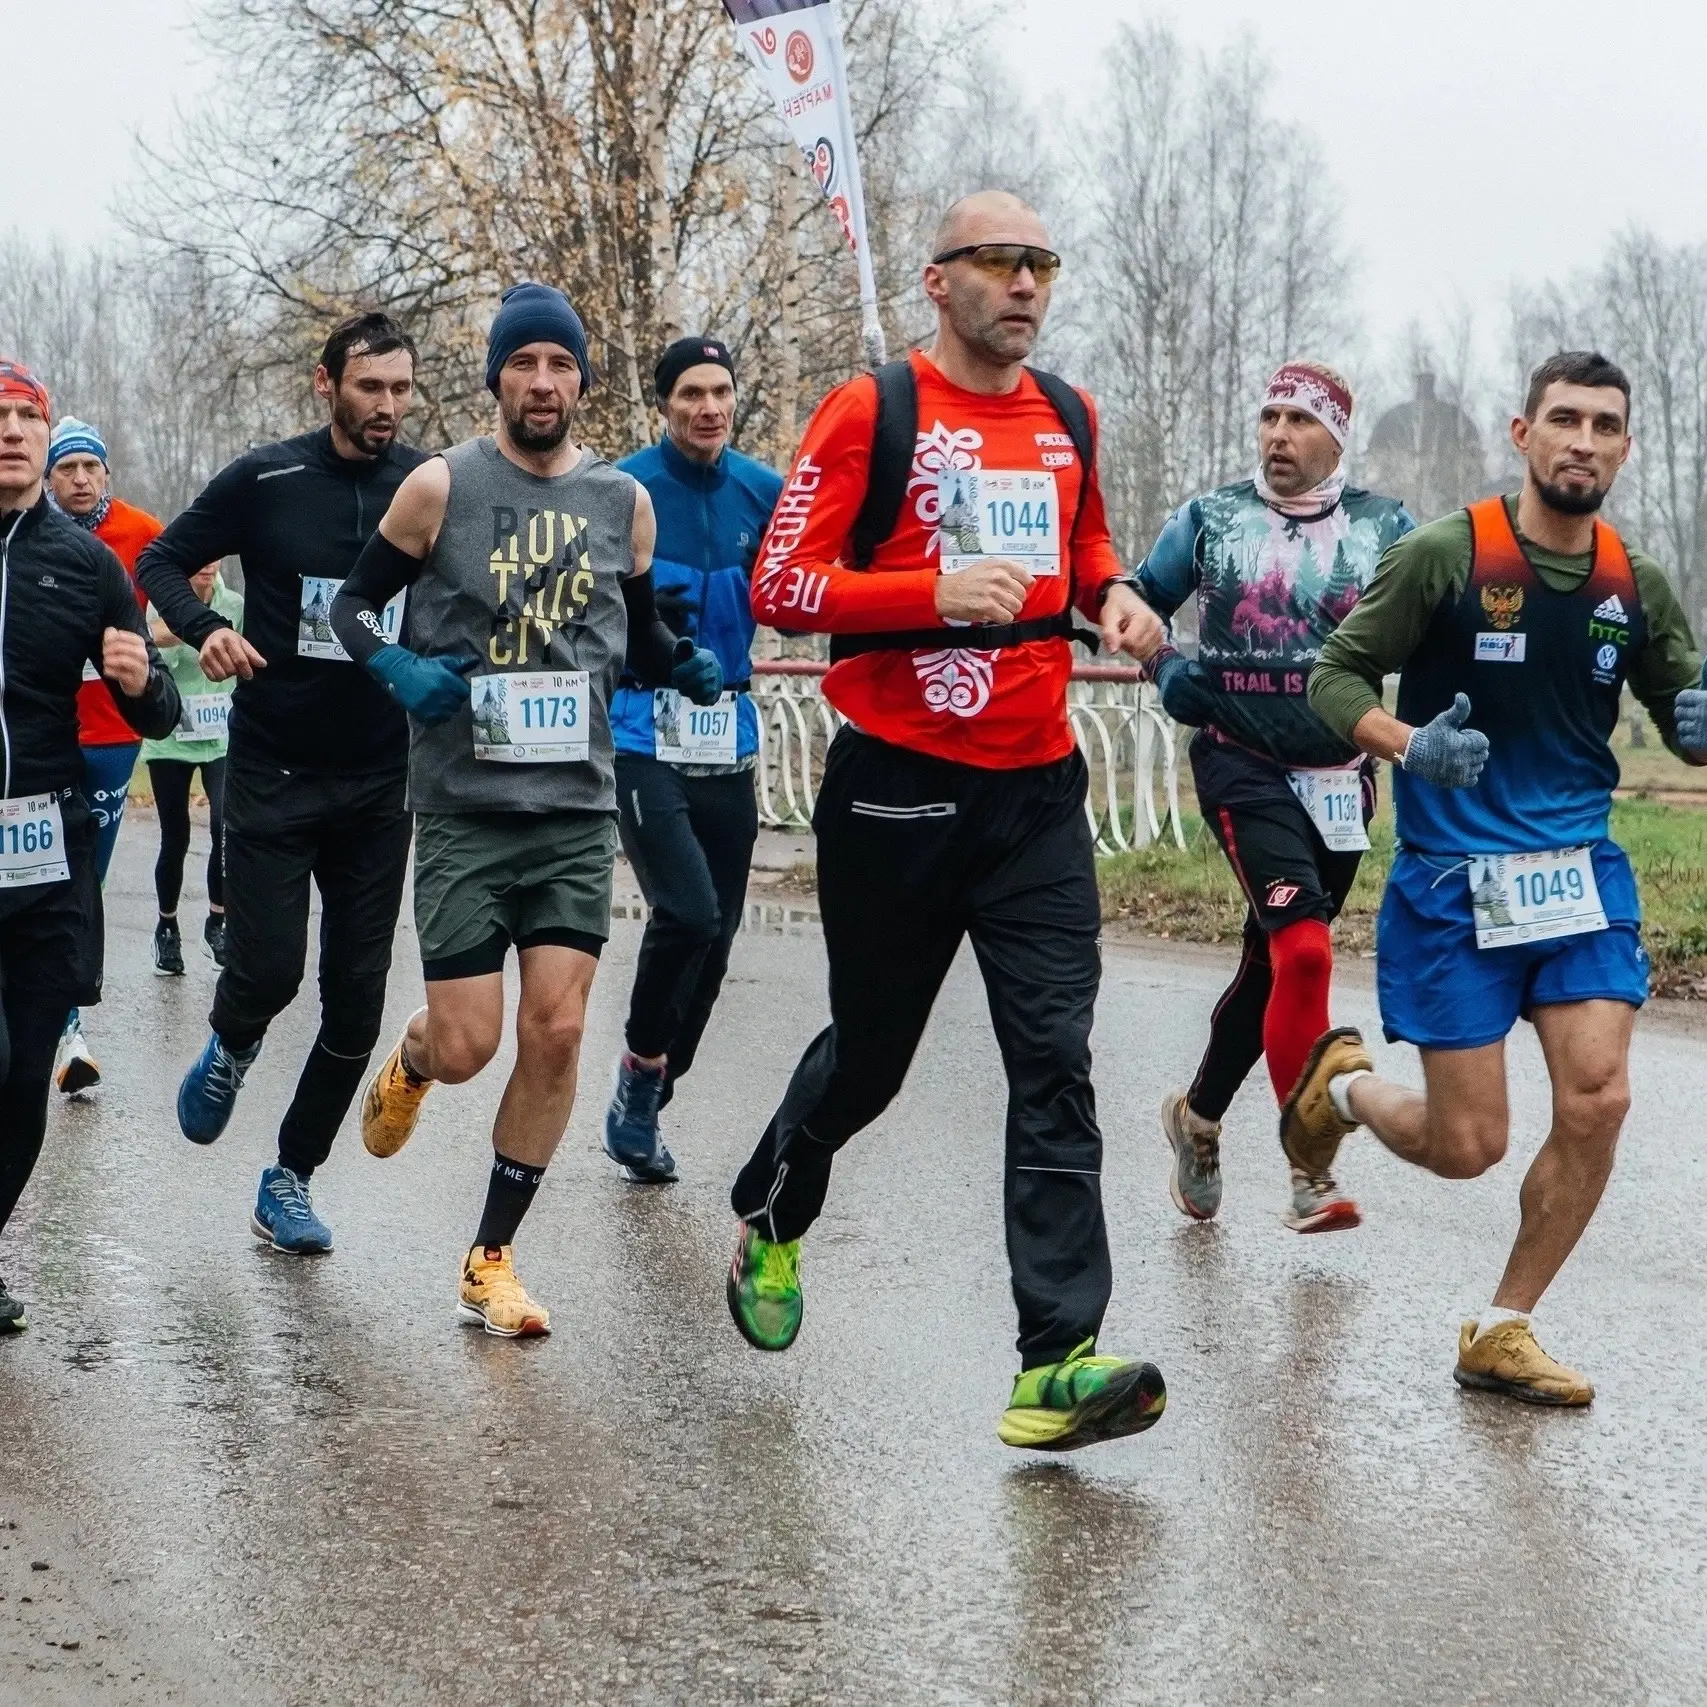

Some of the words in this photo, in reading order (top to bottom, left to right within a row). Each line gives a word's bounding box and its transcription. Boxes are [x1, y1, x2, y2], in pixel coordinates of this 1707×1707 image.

[987, 500, 1050, 537] 1044
[489, 506, 591, 570] RUN
[489, 561, 595, 624] THIS
[1593, 608, 1629, 625] adidas
[552, 676, 563, 689] 10
[1222, 671, 1278, 693] TRAIL
[1284, 672, 1304, 694] IS
[197, 706, 227, 724] 1094
[520, 695, 578, 729] 1173
[689, 711, 729, 737] 1057
[27, 800, 36, 813] 10
[1324, 793, 1357, 822] 1136
[1514, 867, 1585, 908] 1049
[504, 1166, 525, 1182] ME
